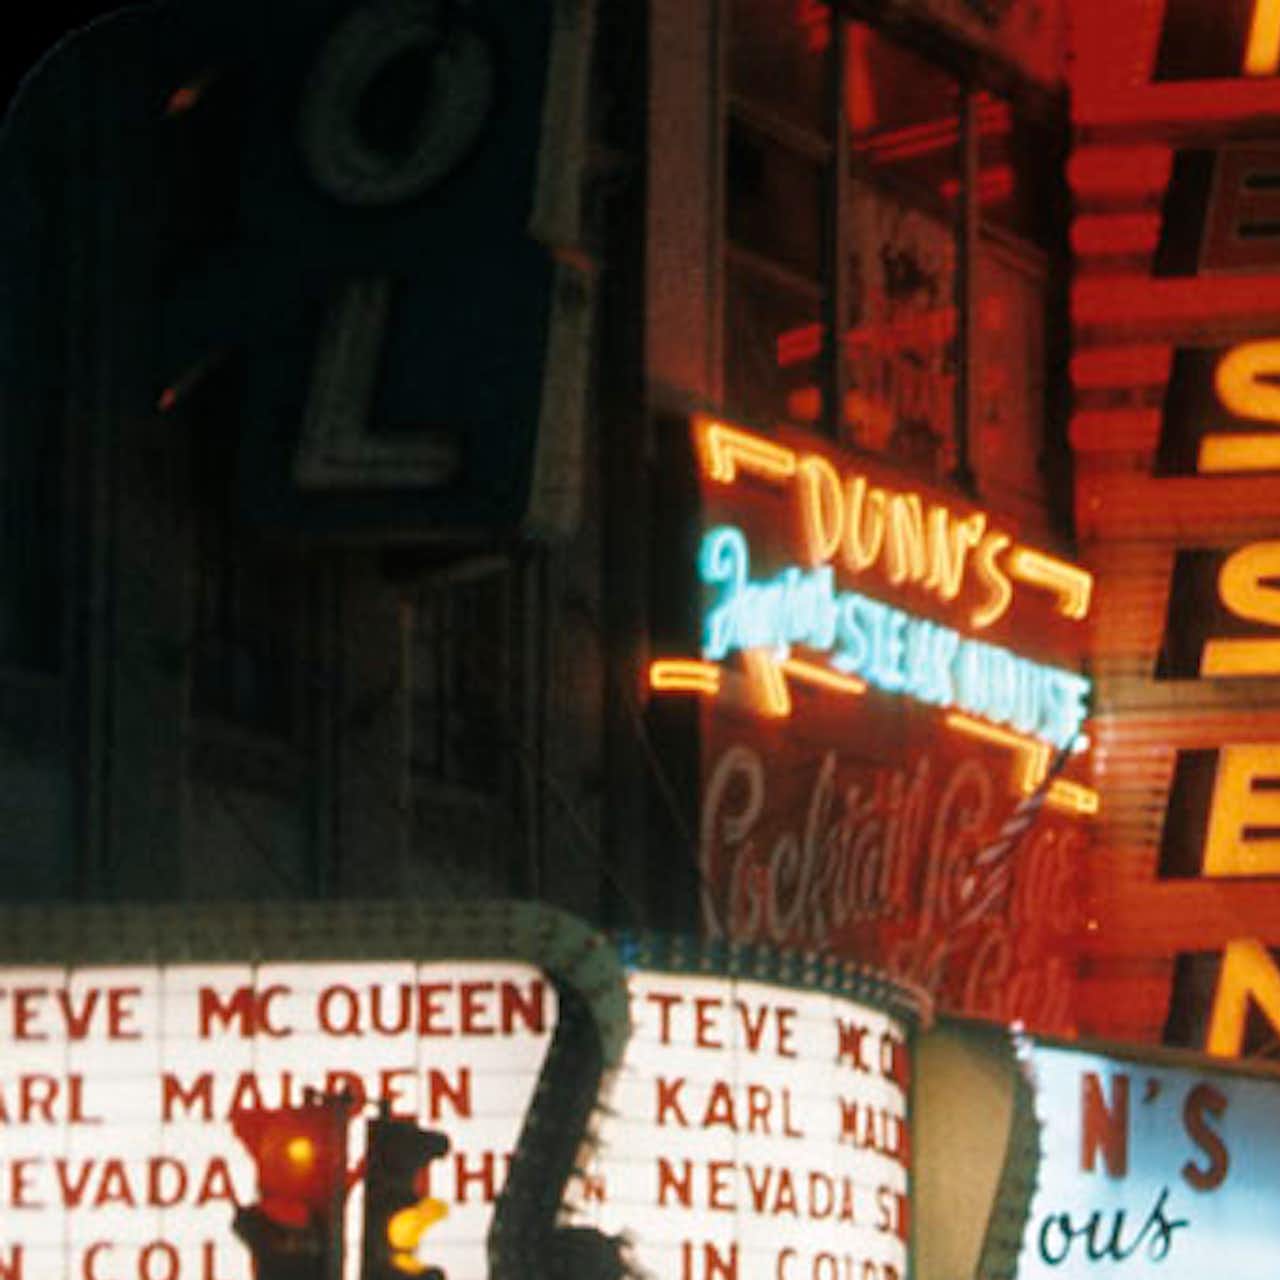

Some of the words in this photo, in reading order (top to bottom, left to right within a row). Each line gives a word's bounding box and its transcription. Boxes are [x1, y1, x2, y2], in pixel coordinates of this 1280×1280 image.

[800, 454, 1013, 629] DUNN'S
[0, 986, 143, 1040] EVE
[316, 980, 545, 1038] QUEEN
[656, 1077, 804, 1138] KARL
[657, 1157, 855, 1222] NEVADA
